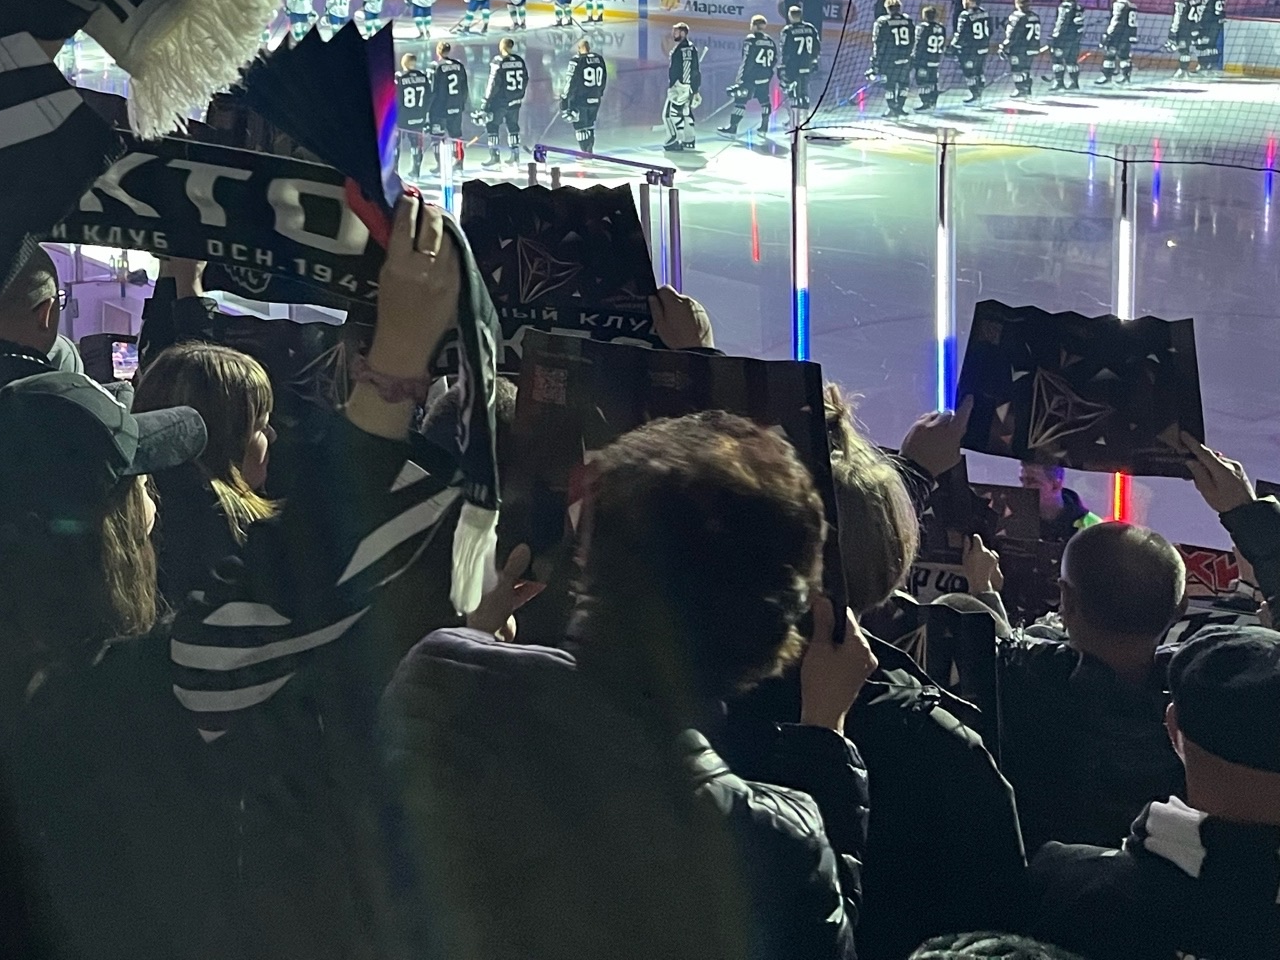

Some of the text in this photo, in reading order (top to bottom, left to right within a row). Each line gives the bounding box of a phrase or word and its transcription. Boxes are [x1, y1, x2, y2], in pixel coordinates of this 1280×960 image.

[684, 0, 744, 15] Маркет
[891, 26, 909, 45] 19
[1026, 24, 1041, 40] 79
[795, 37, 813, 55] 78
[756, 49, 774, 67] 48
[448, 74, 459, 95] 2
[506, 70, 523, 90] 55
[583, 67, 603, 87] 90
[404, 87, 425, 108] 87
[83, 224, 168, 248] КЛУБ
